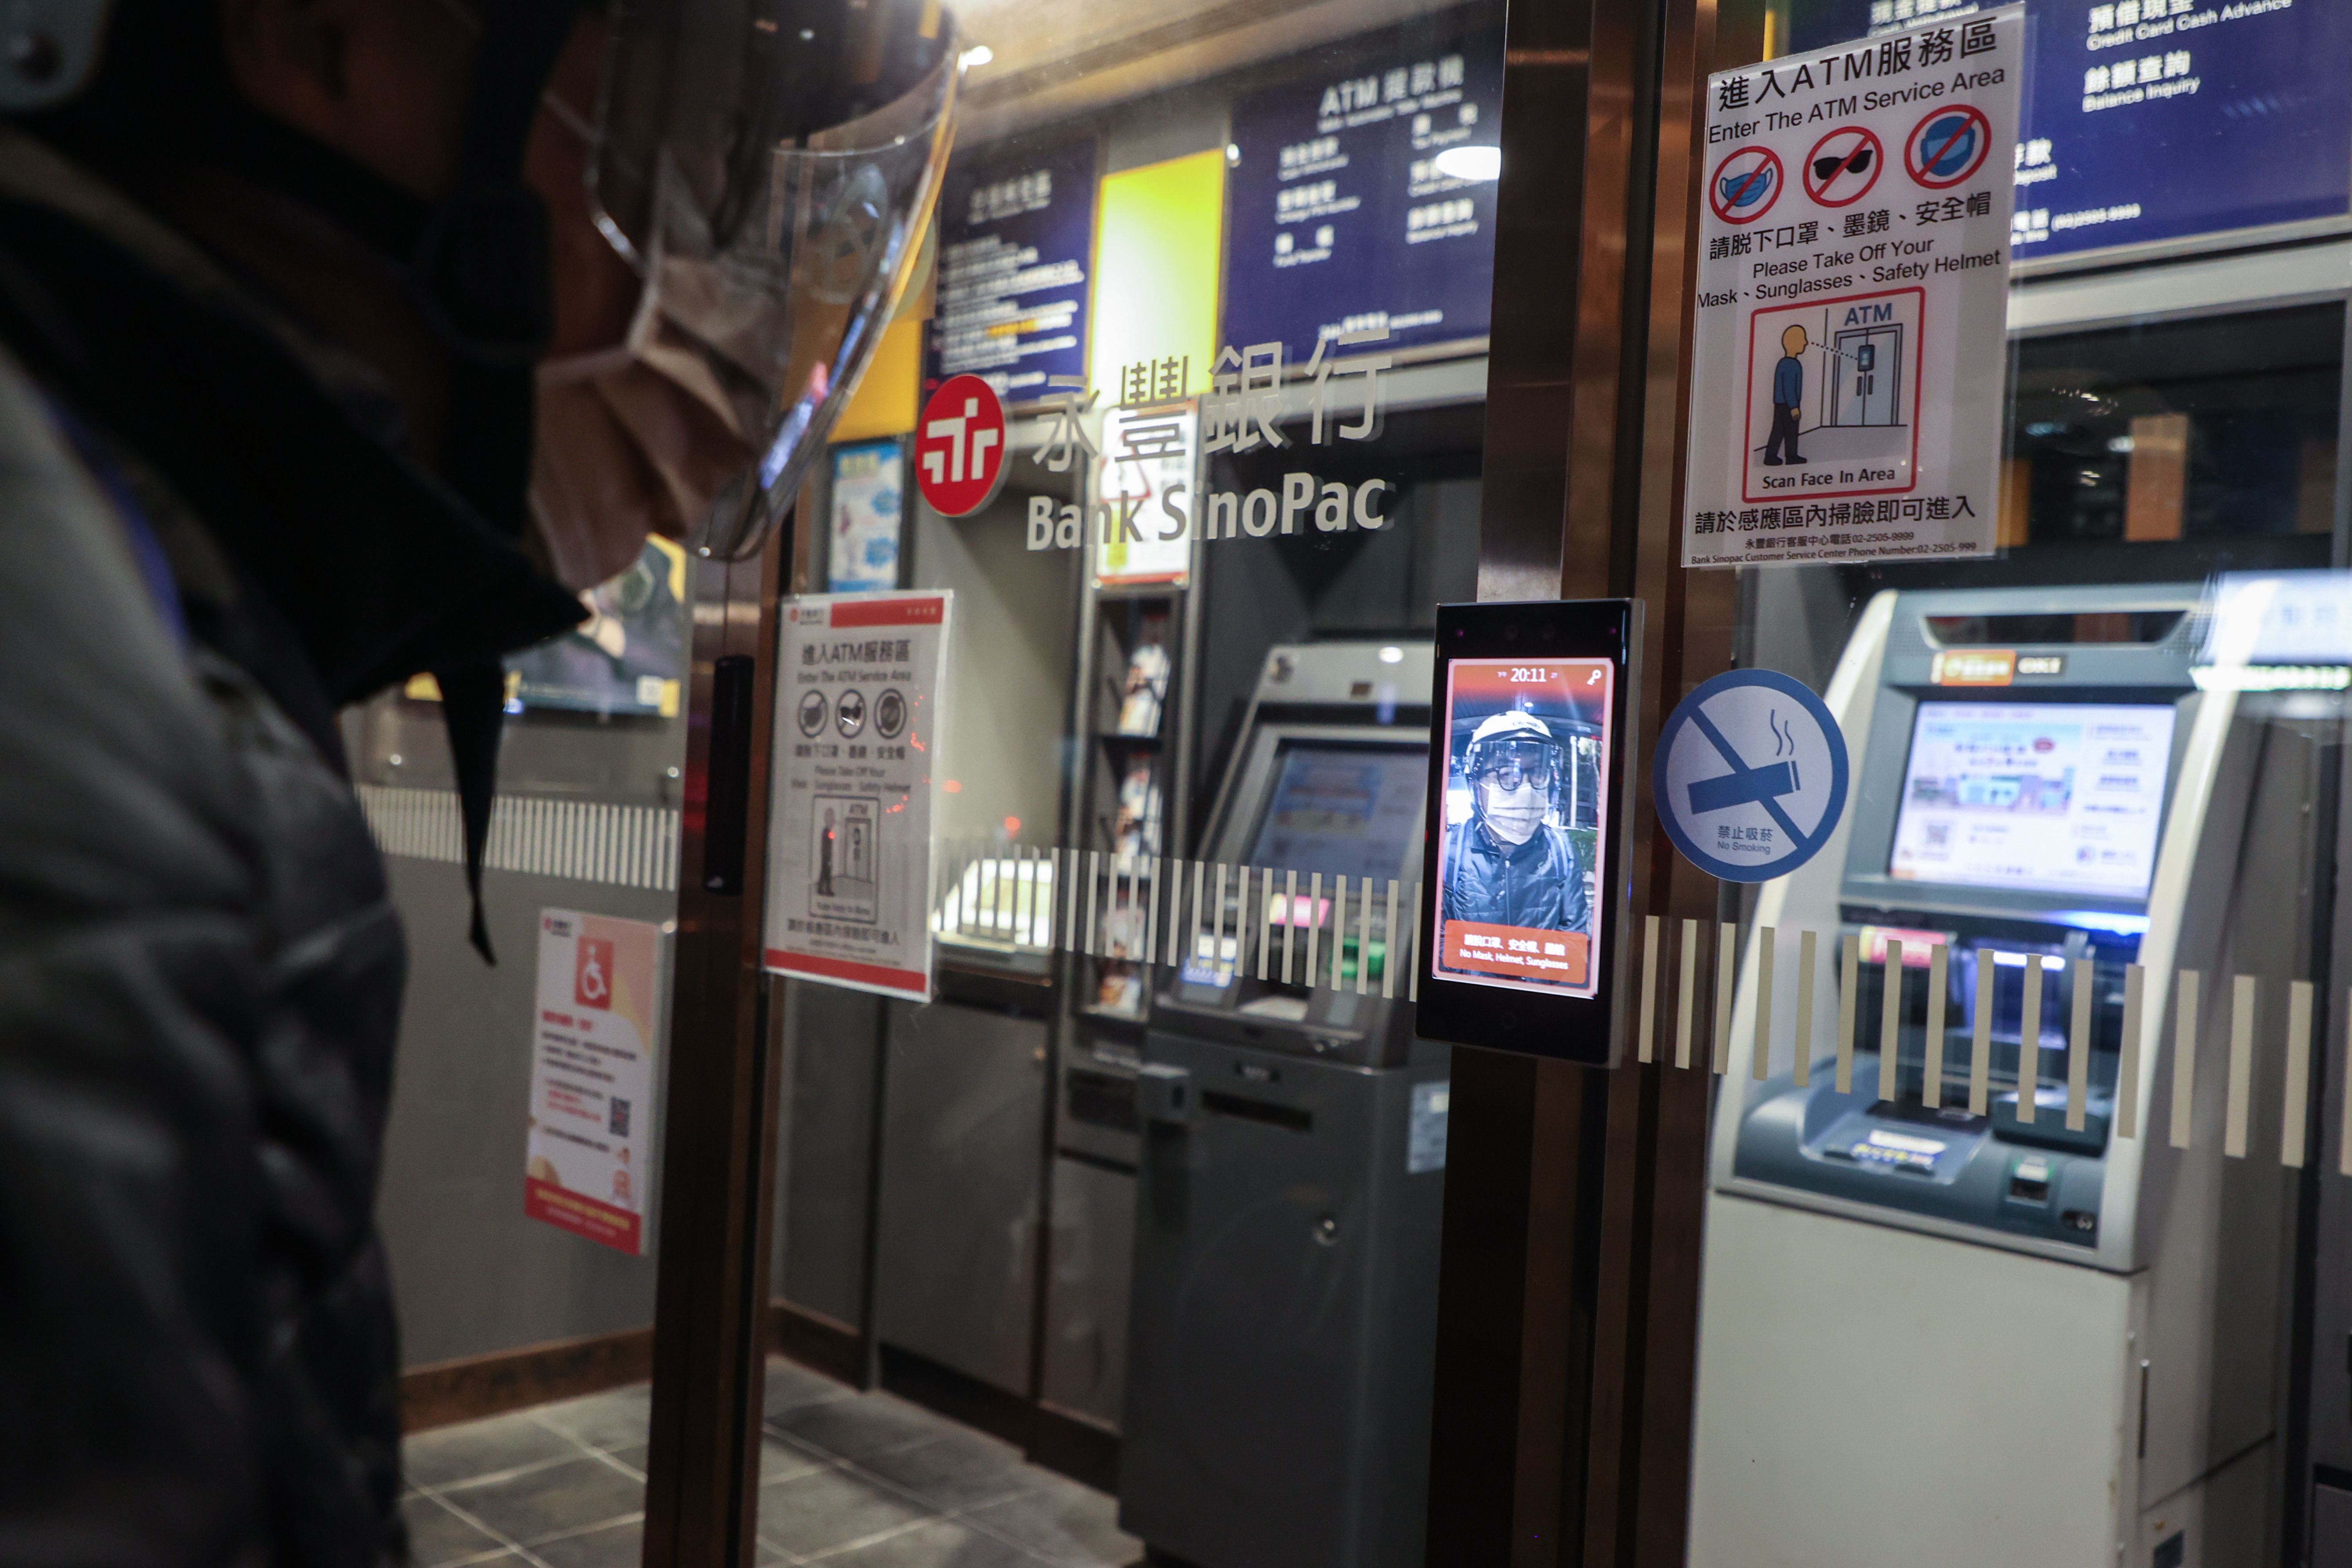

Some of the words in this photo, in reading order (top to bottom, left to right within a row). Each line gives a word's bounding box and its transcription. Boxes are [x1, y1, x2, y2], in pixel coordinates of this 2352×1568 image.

[2087, 26, 2134, 51] Credit
[2135, 17, 2174, 40] Card
[2176, 8, 2218, 31] Cash
[2219, 0, 2292, 21] Advance
[1719, 17, 1997, 112] 進入ATM服務區
[1319, 76, 1379, 116] ATM
[1708, 120, 1759, 144] Enter
[1766, 110, 1802, 132] The
[1808, 95, 1857, 123] ATM
[1864, 81, 1944, 111] Service
[1951, 68, 2005, 93] Area
[2082, 87, 2145, 112] Balance
[2146, 76, 2201, 100] Inquiry
[1753, 257, 1808, 279] Please
[1813, 250, 1854, 268] Take
[1860, 241, 1887, 262] Off
[1892, 236, 1934, 256] Your
[1872, 262, 1929, 283] Safety
[1935, 250, 2000, 274] Helmet
[1845, 303, 1892, 326] ATM
[1032, 327, 1392, 472] 永豐銀行
[1762, 475, 1796, 489] Scan
[1801, 471, 1833, 486] Face
[1840, 470, 1853, 484] In
[1858, 468, 1896, 482] Area
[1026, 491, 1142, 551] Bank
[1158, 472, 1386, 543] SinoPac
[1692, 555, 1710, 565] Bank
[1712, 554, 1743, 564] Sinopac
[1745, 552, 1784, 562] Customer
[1787, 550, 1816, 560] Service
[1818, 548, 1846, 558] Center
[1849, 547, 1876, 556] Phone
[1510, 668, 1547, 682] 20:11
[1718, 825, 1773, 842] 禁止吸菸
[1718, 840, 1730, 850] No
[1732, 842, 1770, 855] Smoking
[1459, 949, 1472, 958] No
[1473, 950, 1494, 962] Mask,
[1495, 952, 1525, 965] Helmet,
[1526, 956, 1569, 970] Sunglasses
